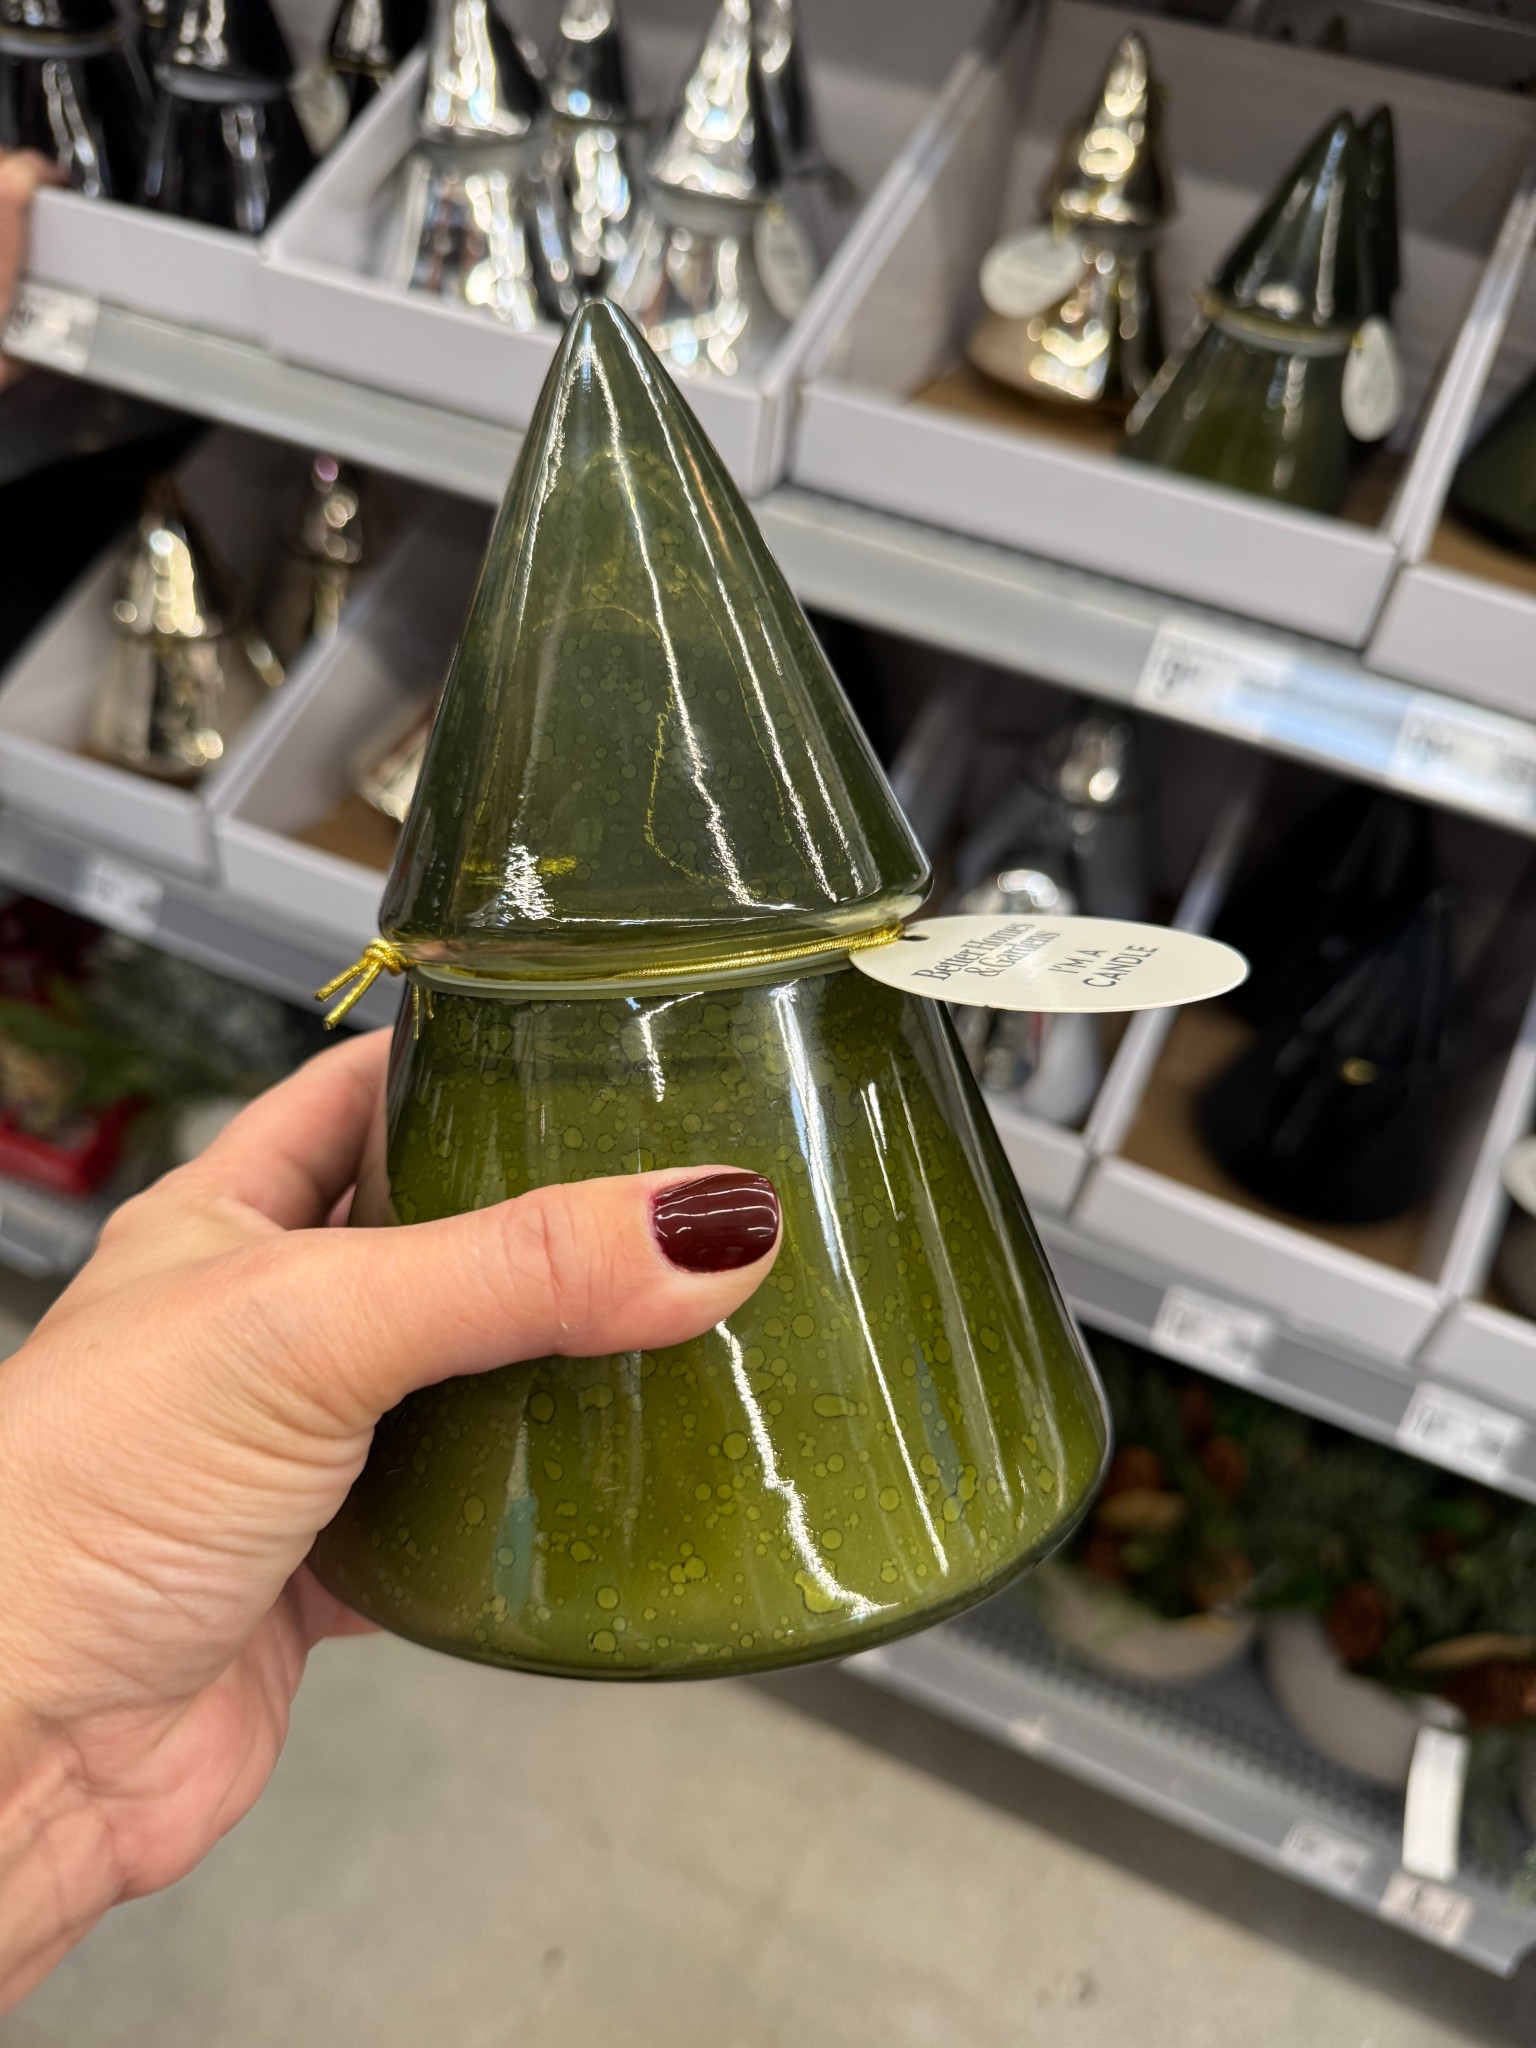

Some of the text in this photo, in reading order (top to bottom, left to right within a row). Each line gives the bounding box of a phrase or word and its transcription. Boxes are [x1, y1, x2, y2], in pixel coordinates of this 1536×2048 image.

[911, 922, 1035, 980] Better Homes
[1048, 957, 1094, 974] I'M
[1082, 945, 1158, 987] CANDLE
